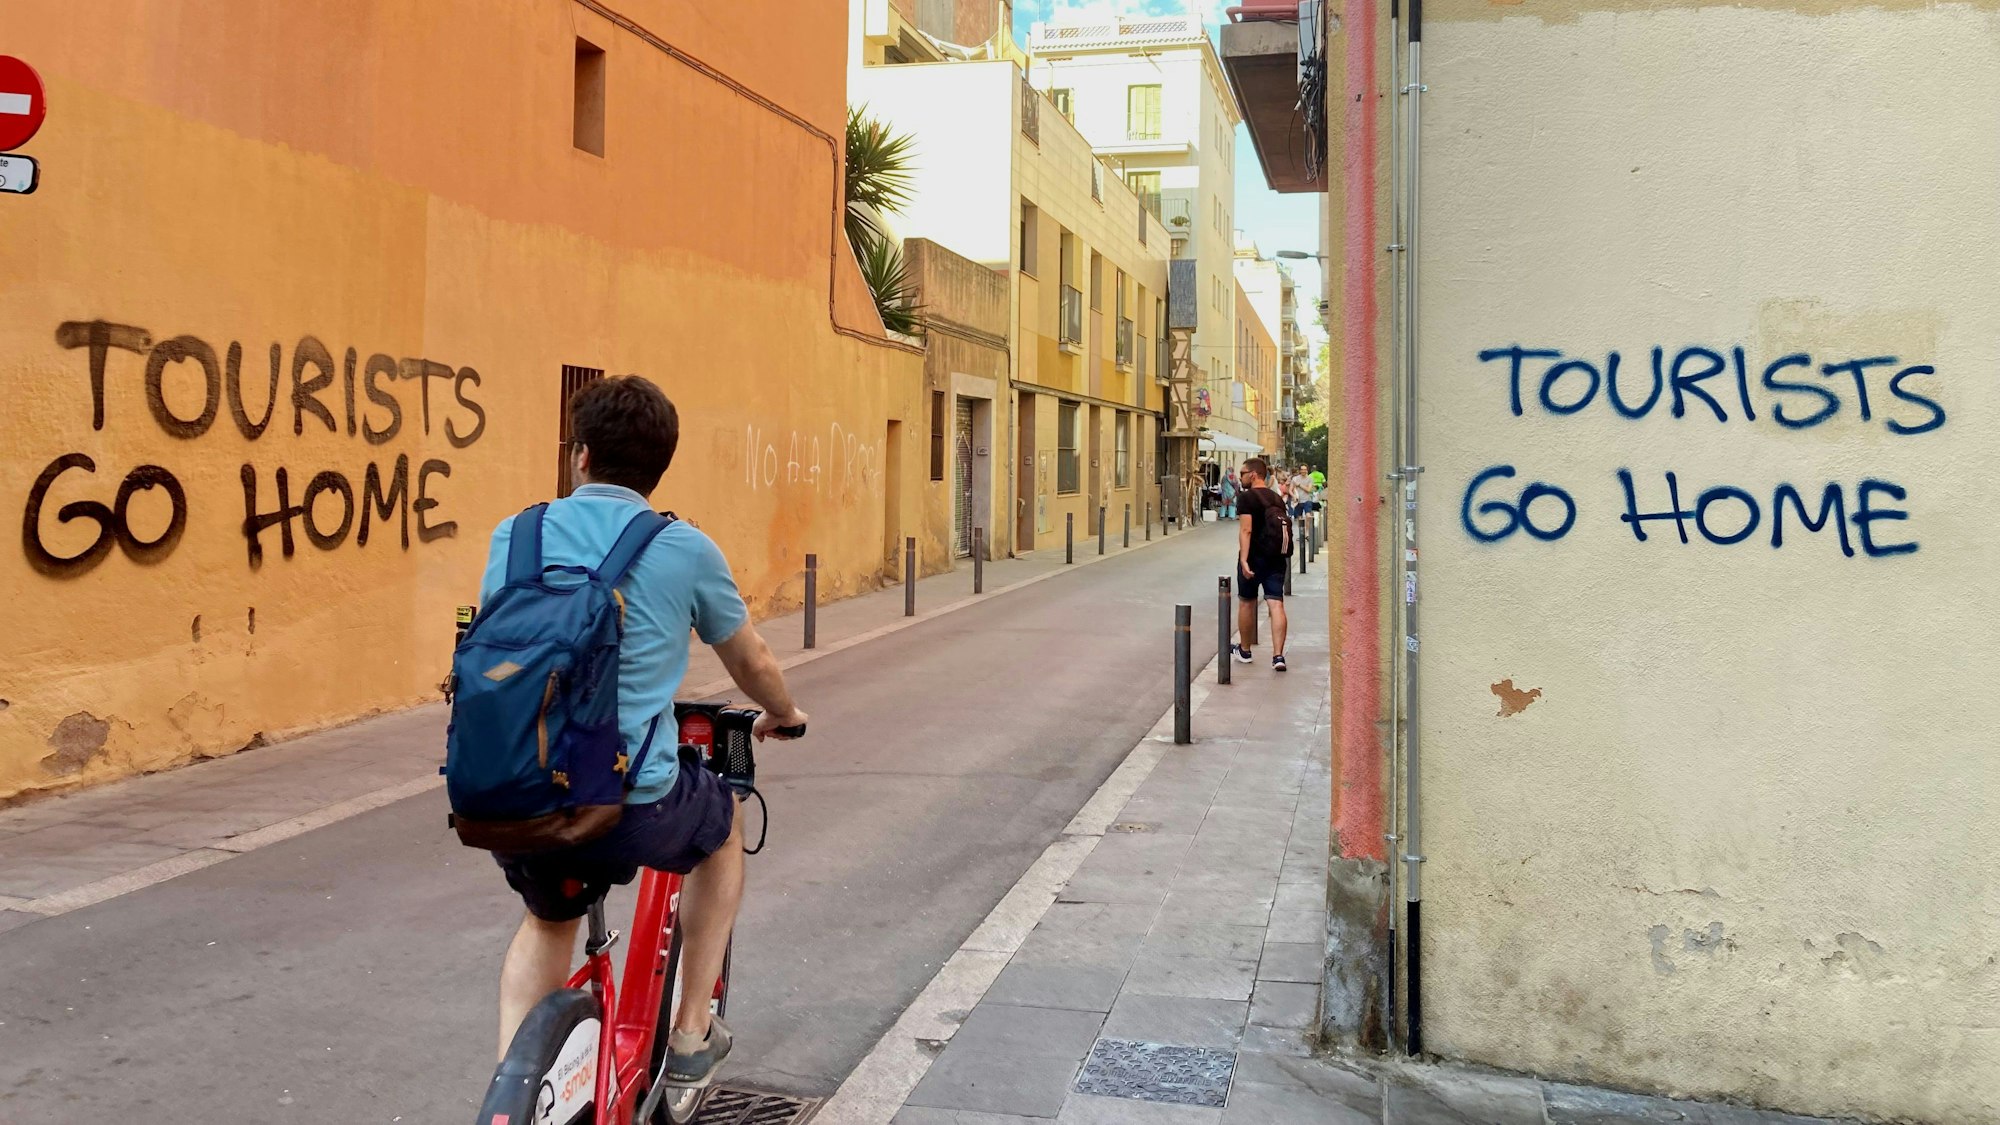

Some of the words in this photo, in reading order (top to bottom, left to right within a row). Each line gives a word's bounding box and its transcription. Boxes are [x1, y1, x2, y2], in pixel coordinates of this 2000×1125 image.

[55, 319, 487, 449] TOURISTS
[1478, 345, 1947, 435] TOURISTS
[22, 452, 187, 580] GO
[241, 453, 458, 571] HOME
[1461, 465, 1577, 543] GO
[1616, 467, 1920, 558] HOME
